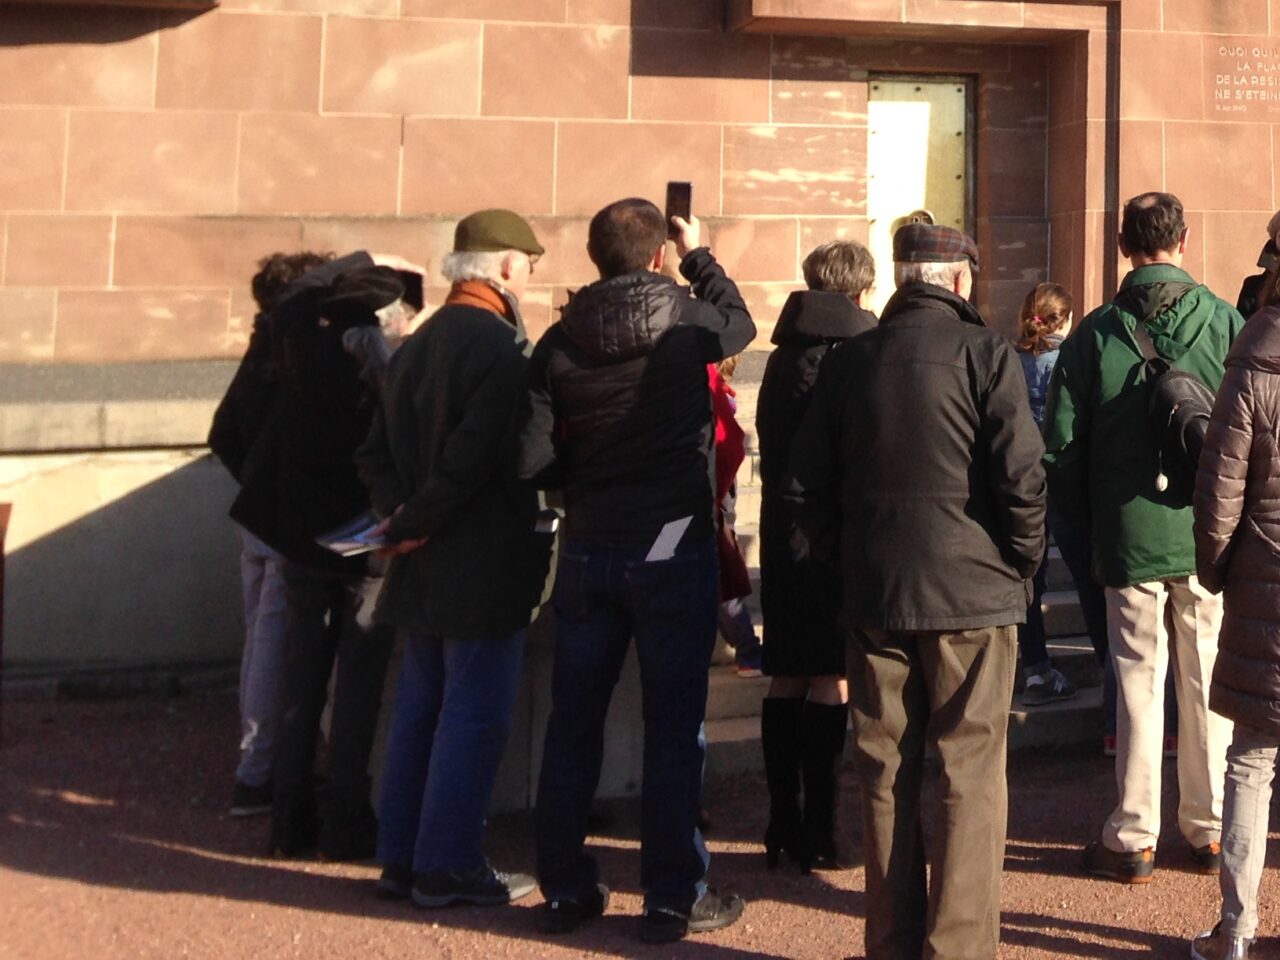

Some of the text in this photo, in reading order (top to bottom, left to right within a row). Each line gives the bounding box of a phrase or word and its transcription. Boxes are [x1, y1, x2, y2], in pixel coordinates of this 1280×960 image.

[1219, 46, 1248, 57] QUOI
[1237, 61, 1251, 71] LA
[1216, 74, 1230, 85] DE
[1233, 75, 1248, 86] LA
[1215, 89, 1230, 100] NE
